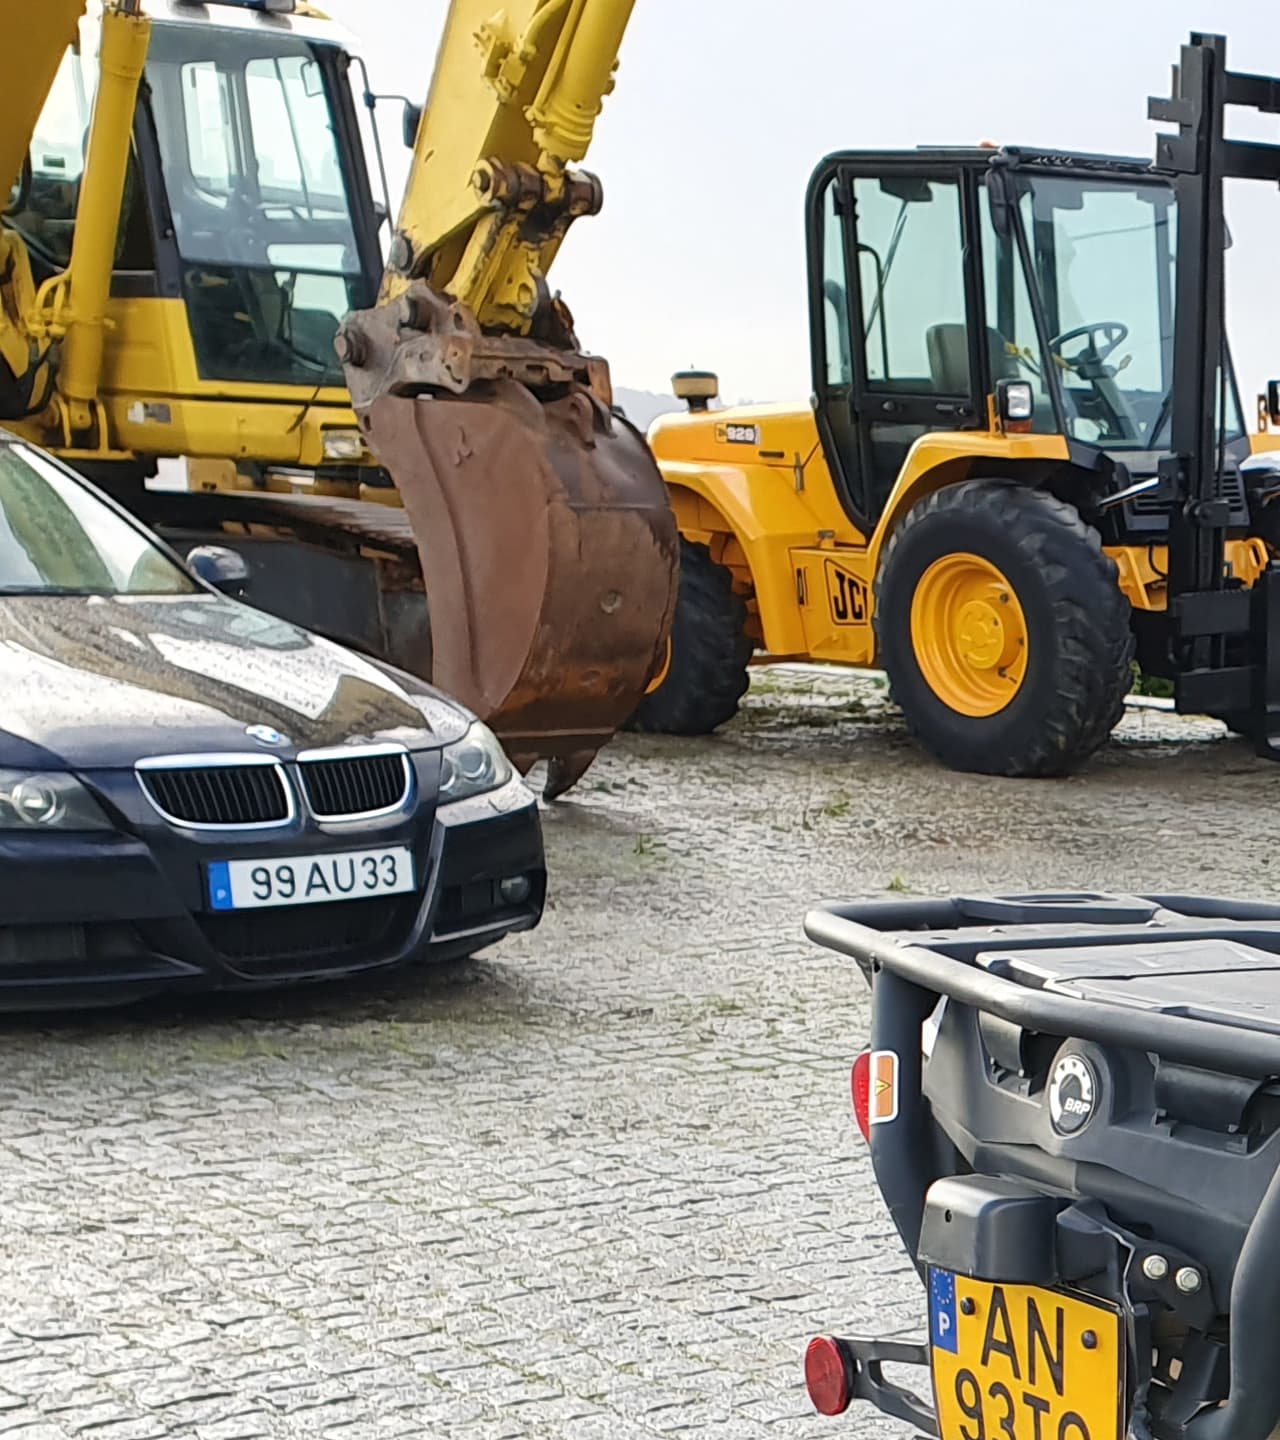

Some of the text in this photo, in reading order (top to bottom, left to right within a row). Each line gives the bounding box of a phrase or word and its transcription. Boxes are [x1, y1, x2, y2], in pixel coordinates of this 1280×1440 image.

[833, 569, 868, 620] JC
[1064, 1097, 1091, 1115] BRP
[938, 1311, 950, 1336] P
[981, 1286, 1064, 1397] AN
